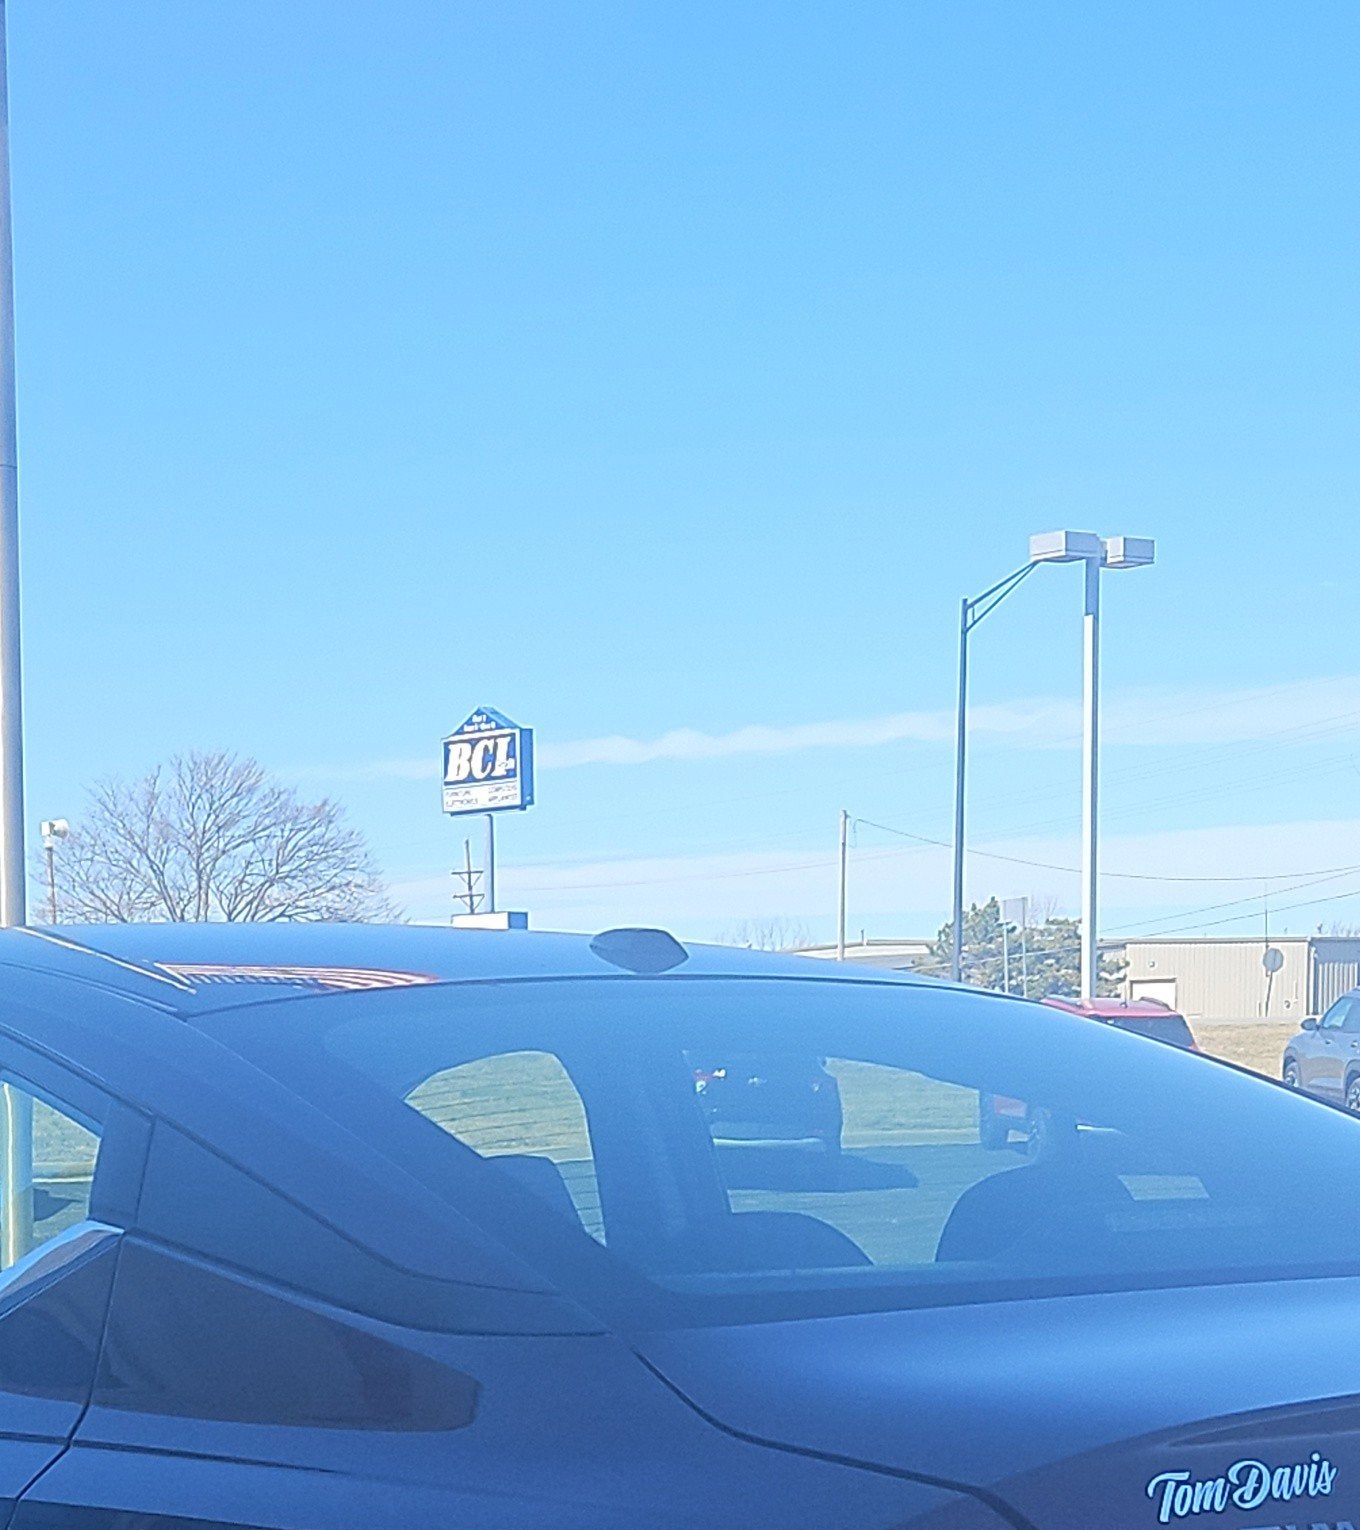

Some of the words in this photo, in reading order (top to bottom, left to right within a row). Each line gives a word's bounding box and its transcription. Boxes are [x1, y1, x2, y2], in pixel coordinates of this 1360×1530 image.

[445, 736, 515, 781] BCL
[1146, 1470, 1230, 1524] Tom
[1227, 1452, 1337, 1511] Davis
